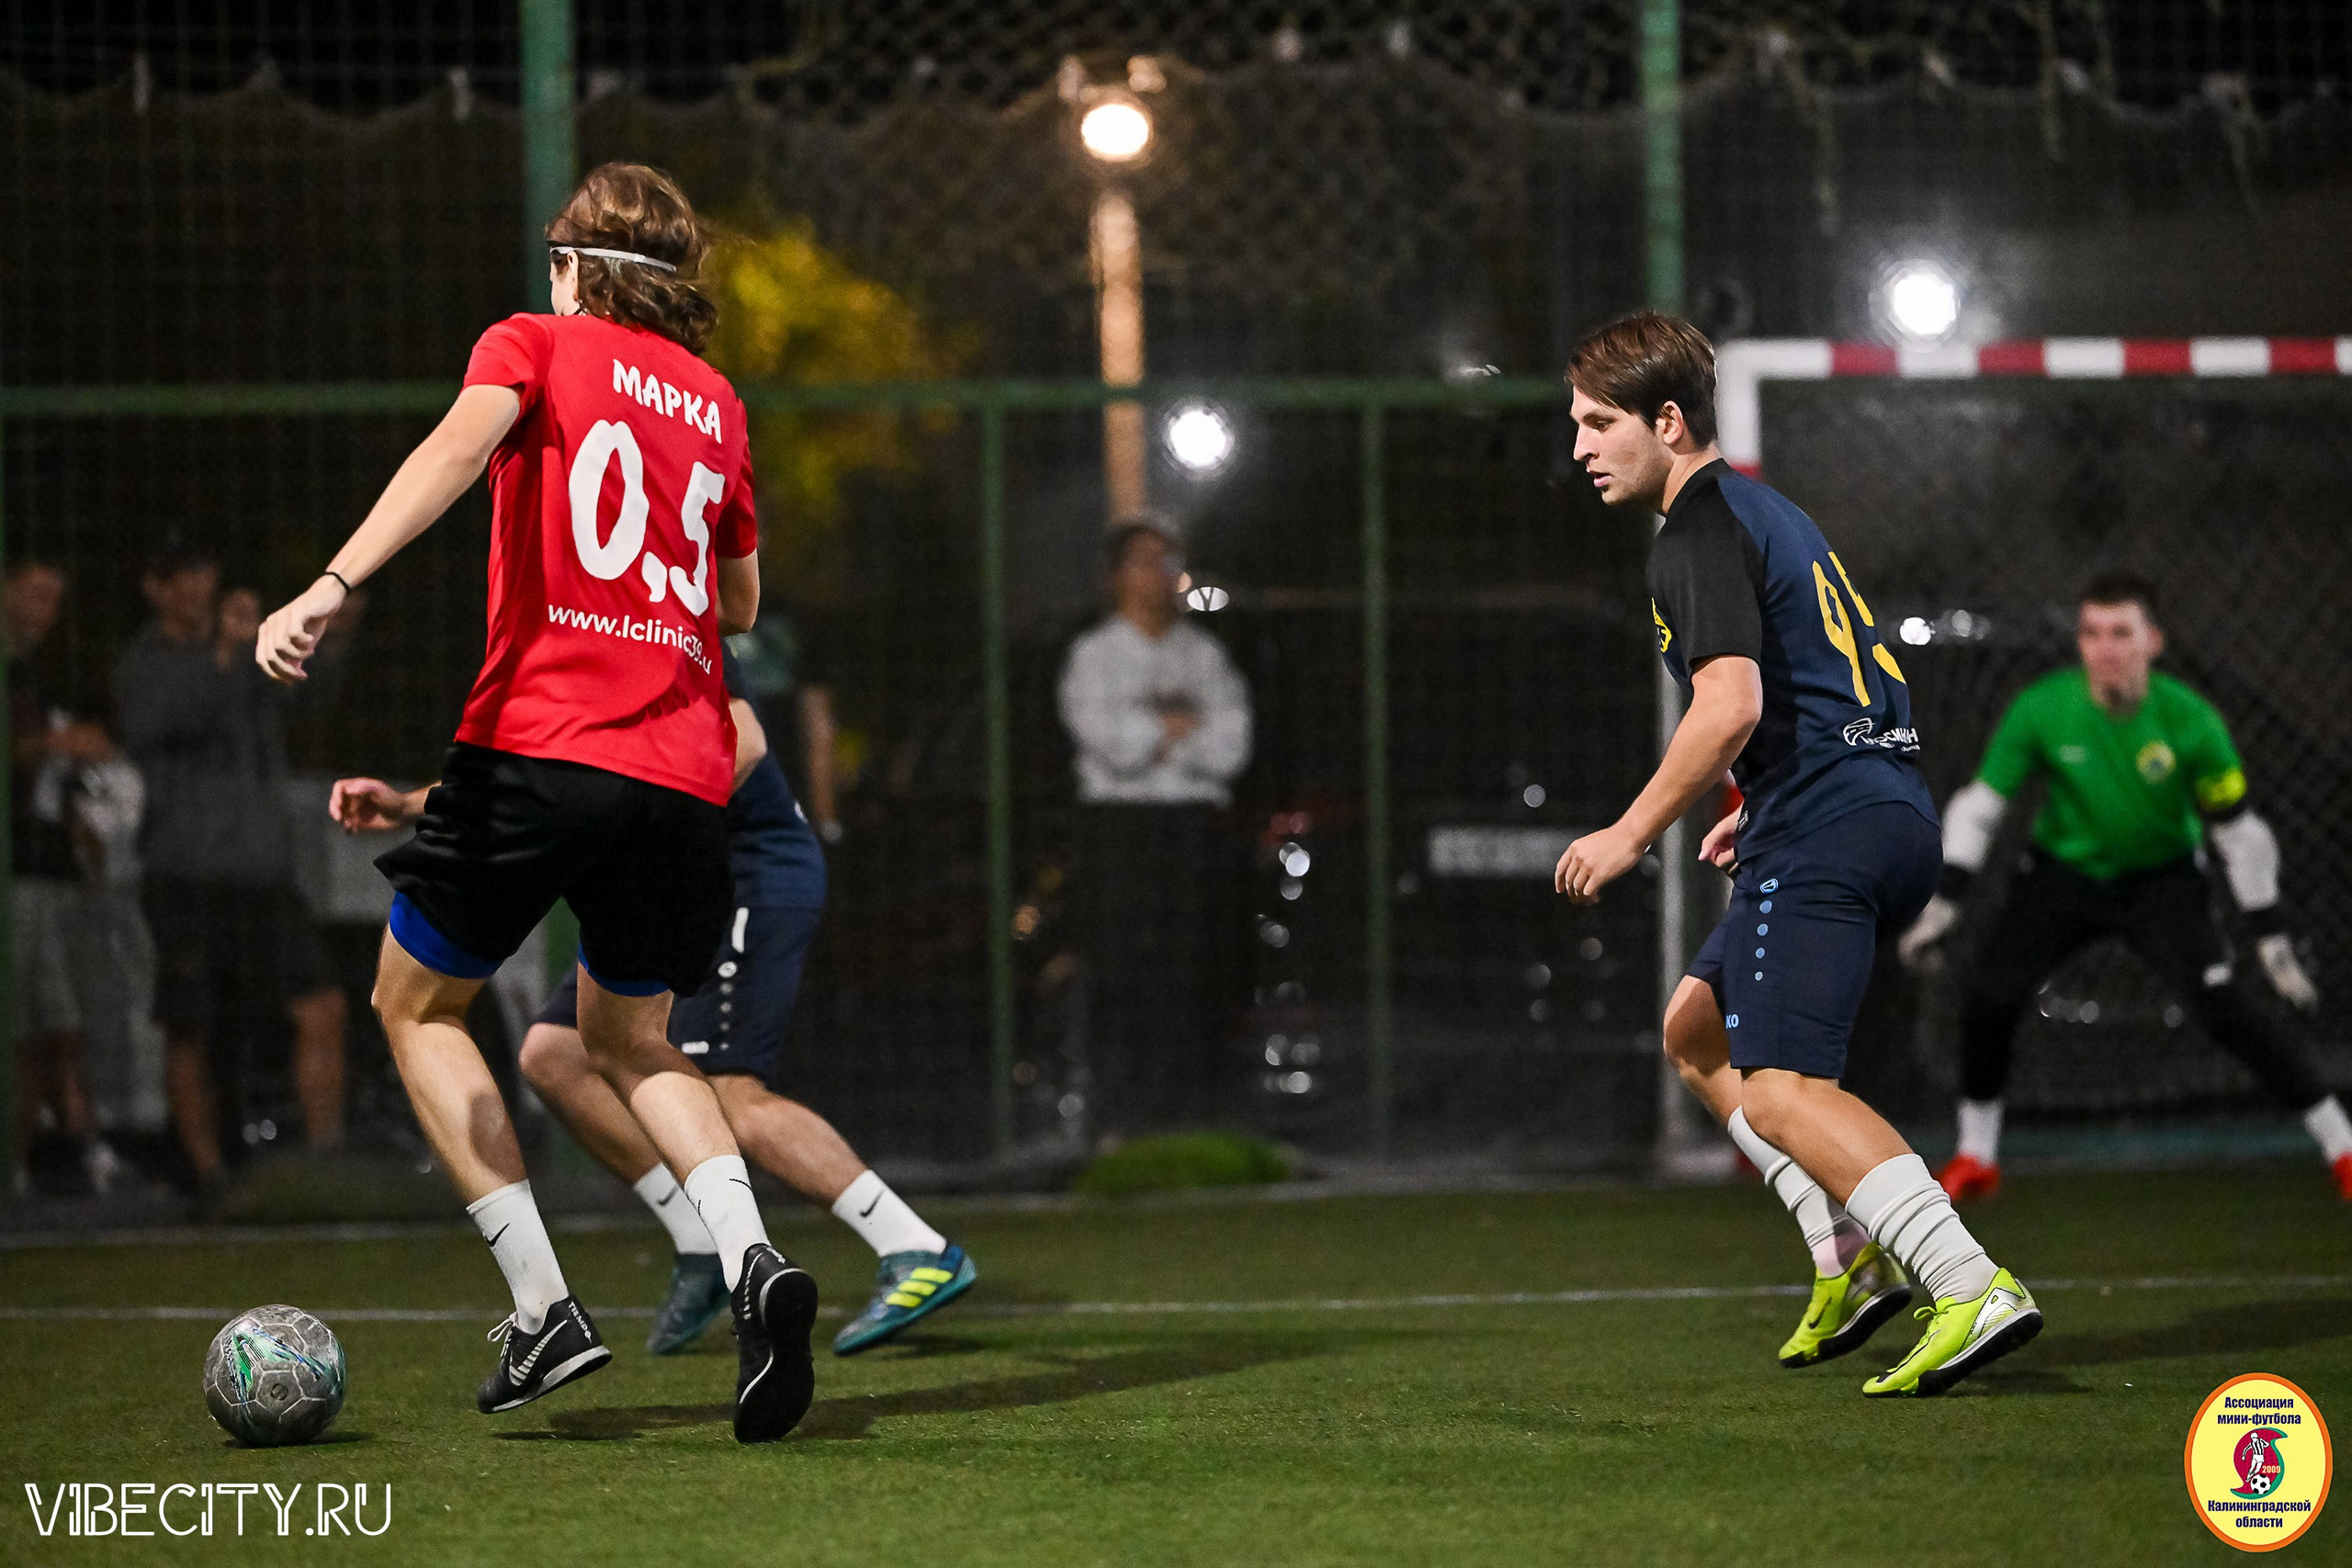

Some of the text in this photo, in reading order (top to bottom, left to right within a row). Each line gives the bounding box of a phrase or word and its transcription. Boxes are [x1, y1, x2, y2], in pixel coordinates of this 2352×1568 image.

[612, 357, 722, 444] МАРКА
[568, 419, 726, 616] 0,5
[1812, 551, 1906, 707] 95
[568, 1301, 593, 1342] TIEMPO
